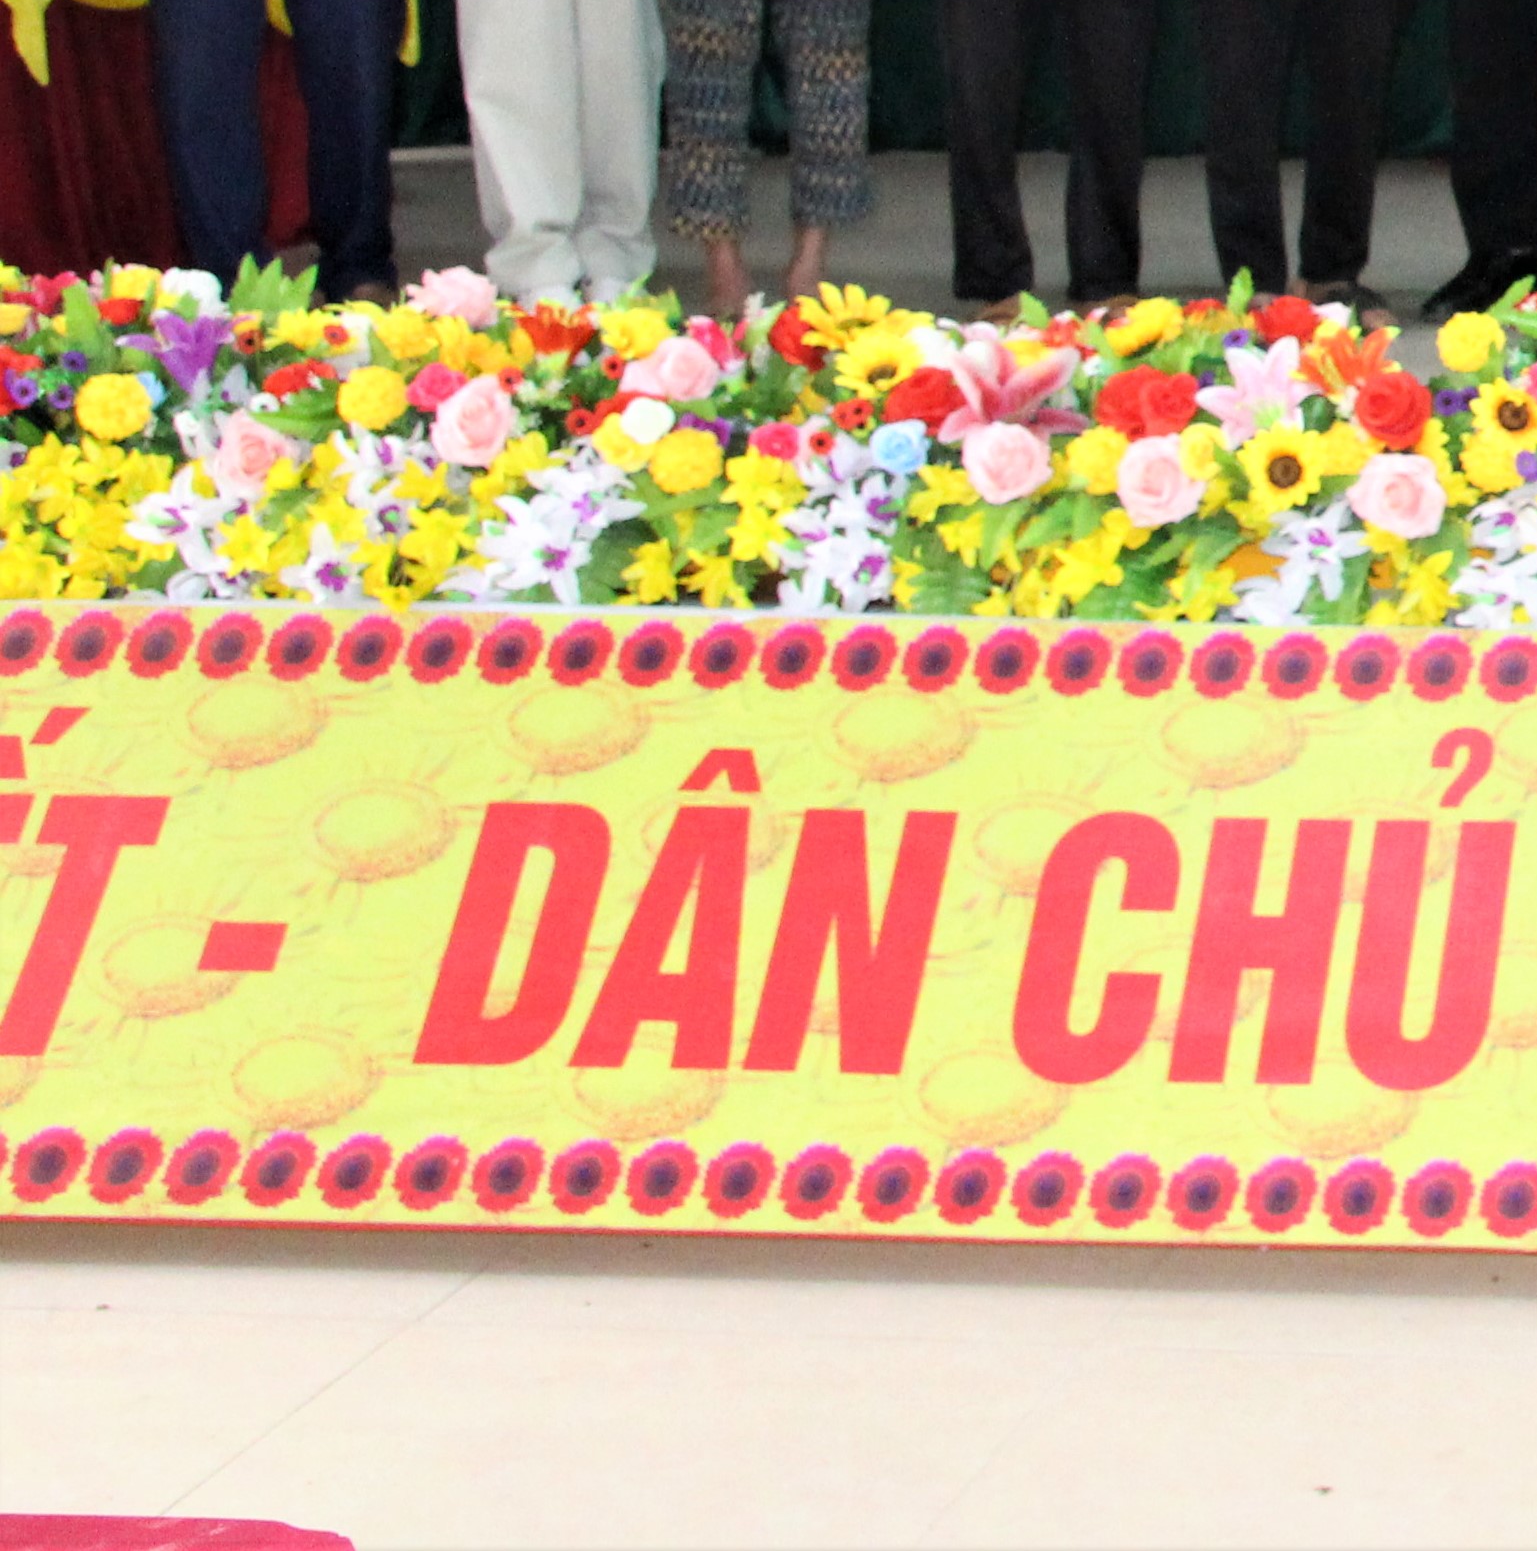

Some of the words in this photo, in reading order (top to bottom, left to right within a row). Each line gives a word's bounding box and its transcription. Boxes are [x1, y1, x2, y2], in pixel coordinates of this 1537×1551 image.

[0, 706, 172, 1057] T
[196, 921, 288, 973] -
[412, 748, 958, 1076] DÂN
[1010, 727, 1517, 1091] CHỦ
